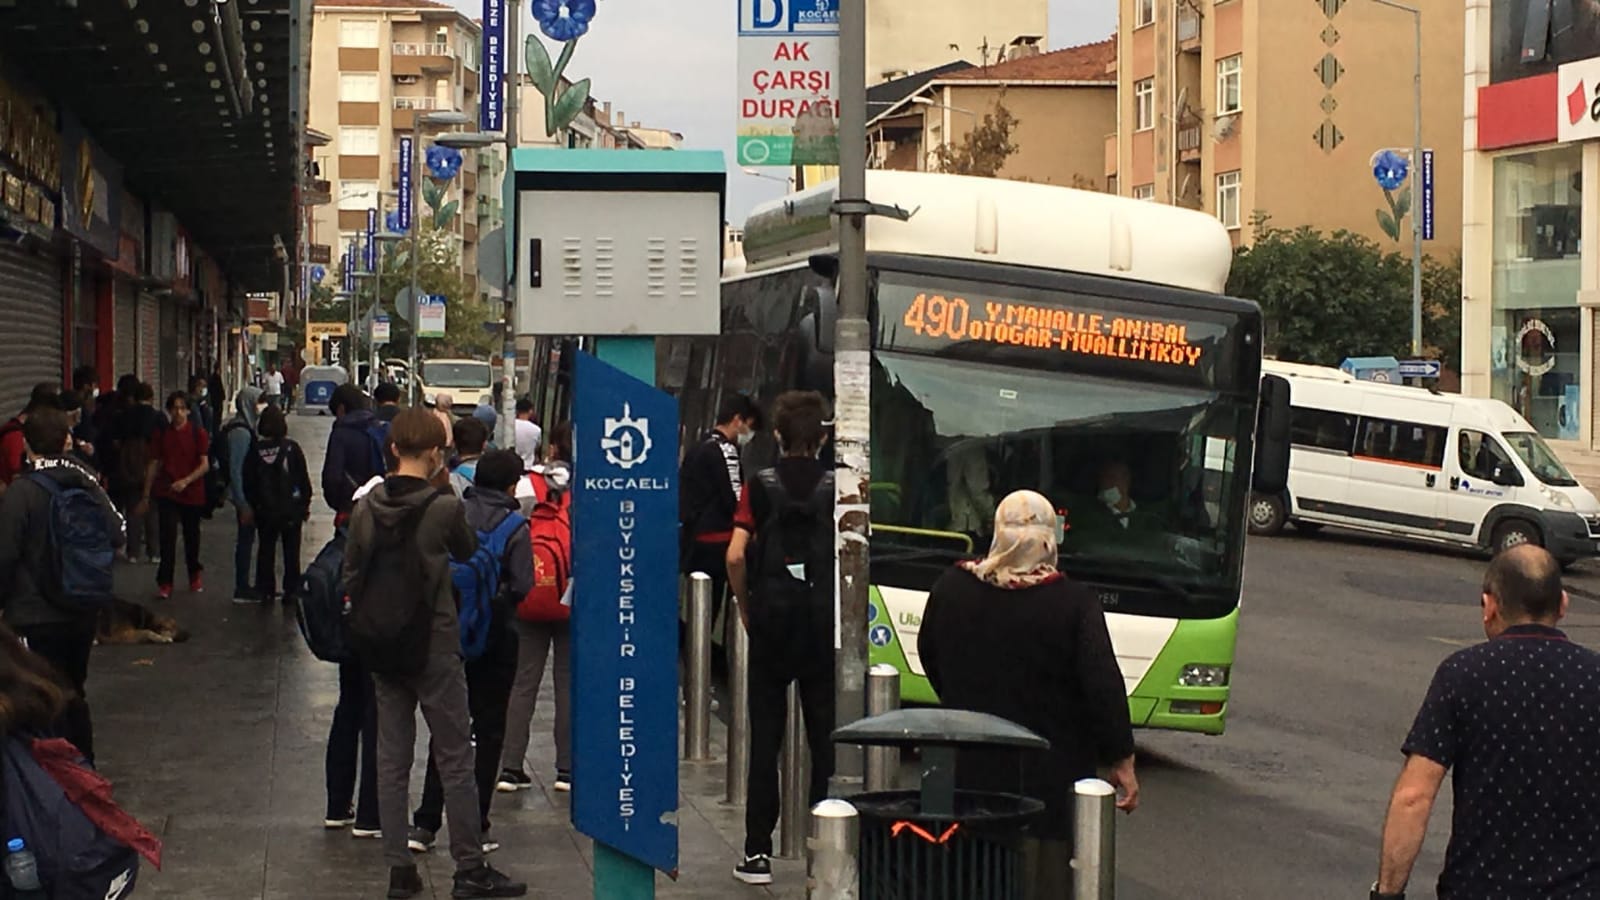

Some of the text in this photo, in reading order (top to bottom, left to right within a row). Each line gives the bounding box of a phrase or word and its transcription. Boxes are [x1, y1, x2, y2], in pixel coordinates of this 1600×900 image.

[773, 41, 810, 61] AK
[752, 70, 831, 95] ÇARŞI
[742, 95, 840, 118] DURAĞI
[904, 293, 969, 340] 490
[618, 500, 636, 832] BÜYÜKŞEHİR BELEDİYESİ
